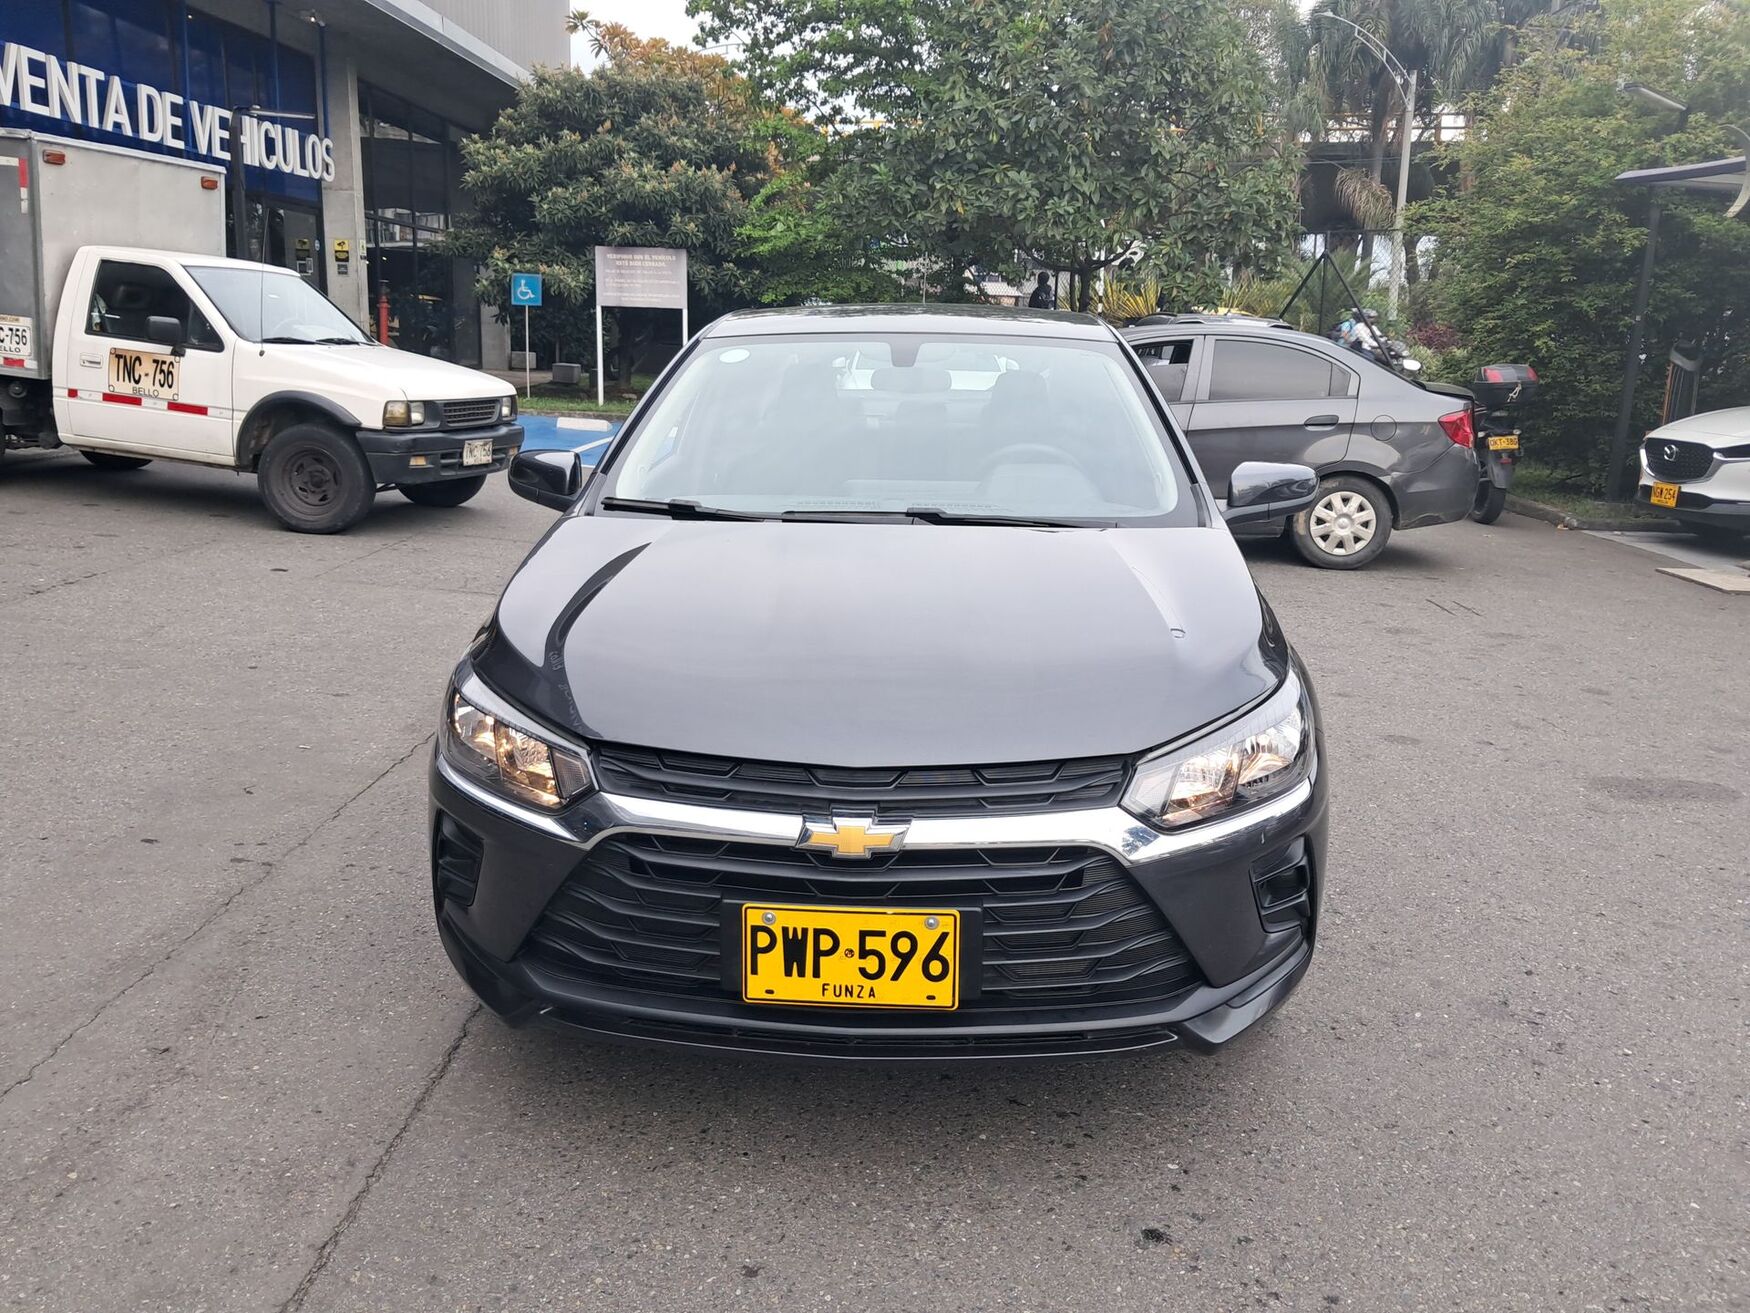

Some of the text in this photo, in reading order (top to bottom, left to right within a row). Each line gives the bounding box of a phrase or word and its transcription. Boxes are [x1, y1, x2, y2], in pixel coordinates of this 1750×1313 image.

[0, 42, 132, 137] VENTA
[136, 84, 186, 150] DE
[132, 386, 160, 398] BELLO
[821, 982, 876, 999] FUNZA
